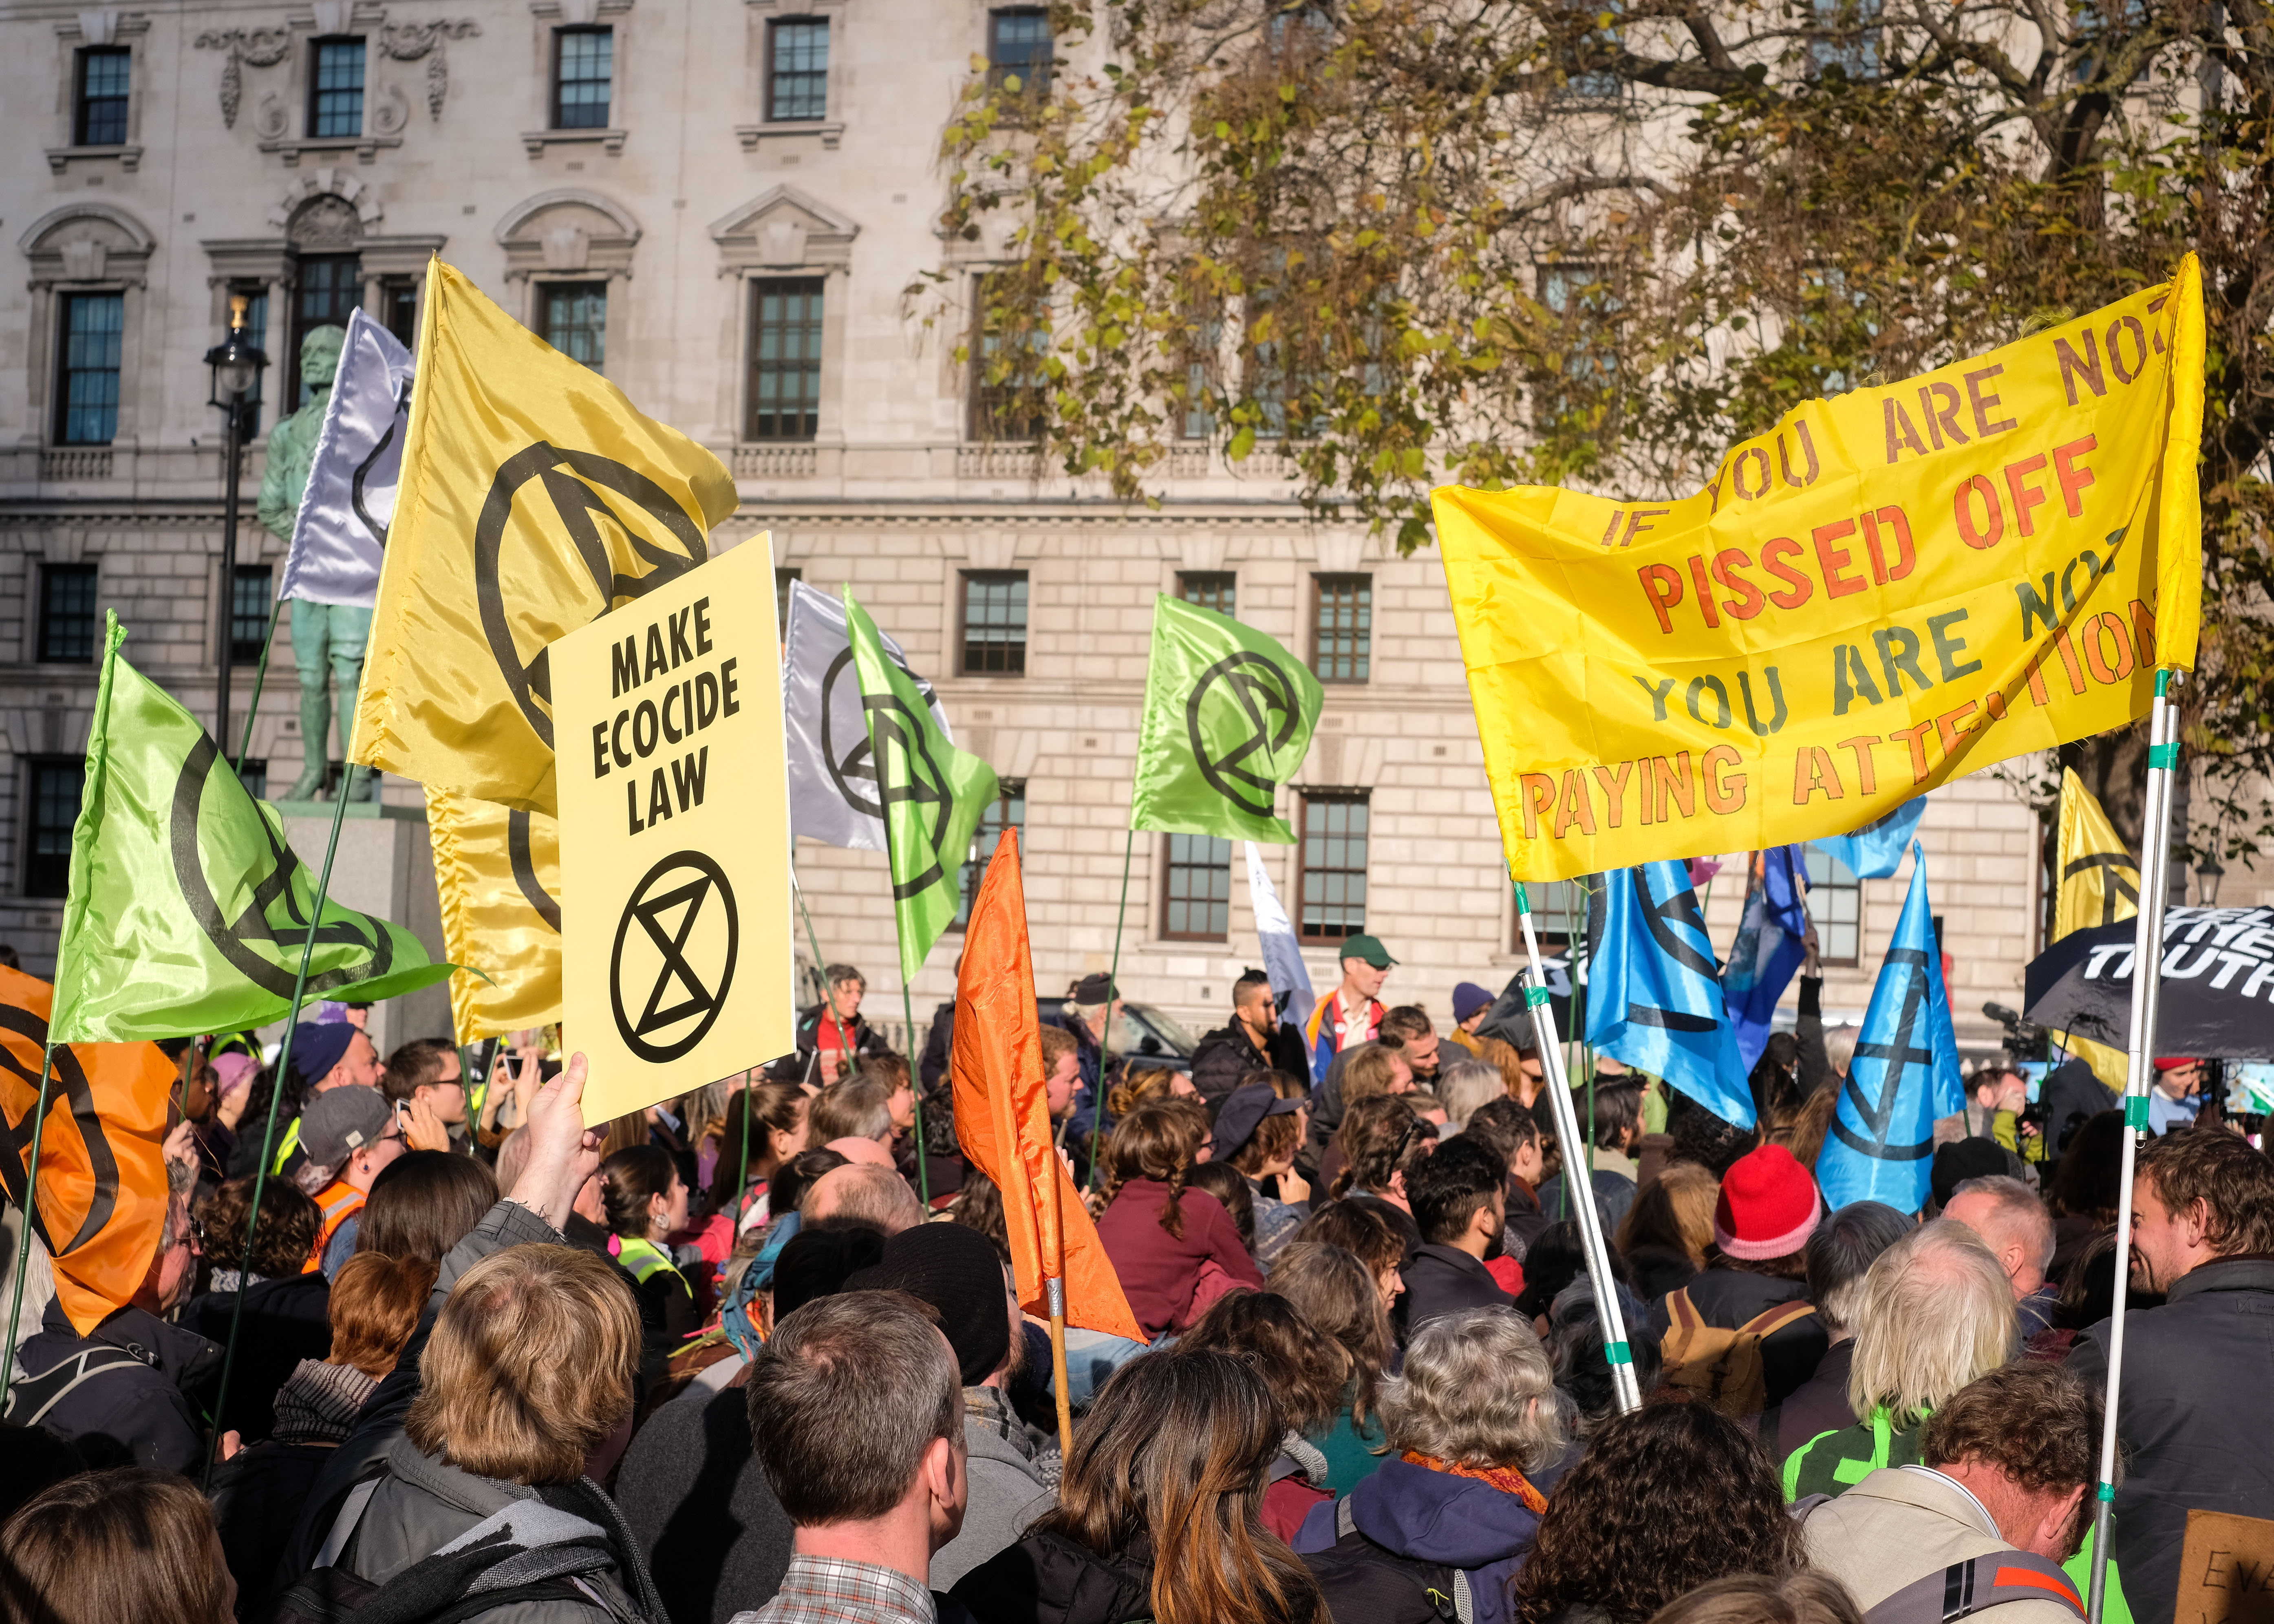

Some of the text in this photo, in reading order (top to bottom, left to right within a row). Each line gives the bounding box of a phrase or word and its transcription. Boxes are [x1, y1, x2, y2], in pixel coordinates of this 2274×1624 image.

[1601, 509, 1670, 546] IF
[1707, 419, 1820, 516] YOU
[1882, 363, 2018, 464] ARE
[1637, 432, 2098, 634] PISSED OFF
[612, 596, 712, 699] MAKE
[1632, 666, 1788, 736] YOU
[1833, 608, 1982, 716] ARE
[592, 657, 739, 779] ECOCIDE
[627, 745, 709, 836] LAW
[1520, 744, 1747, 839] PAYING
